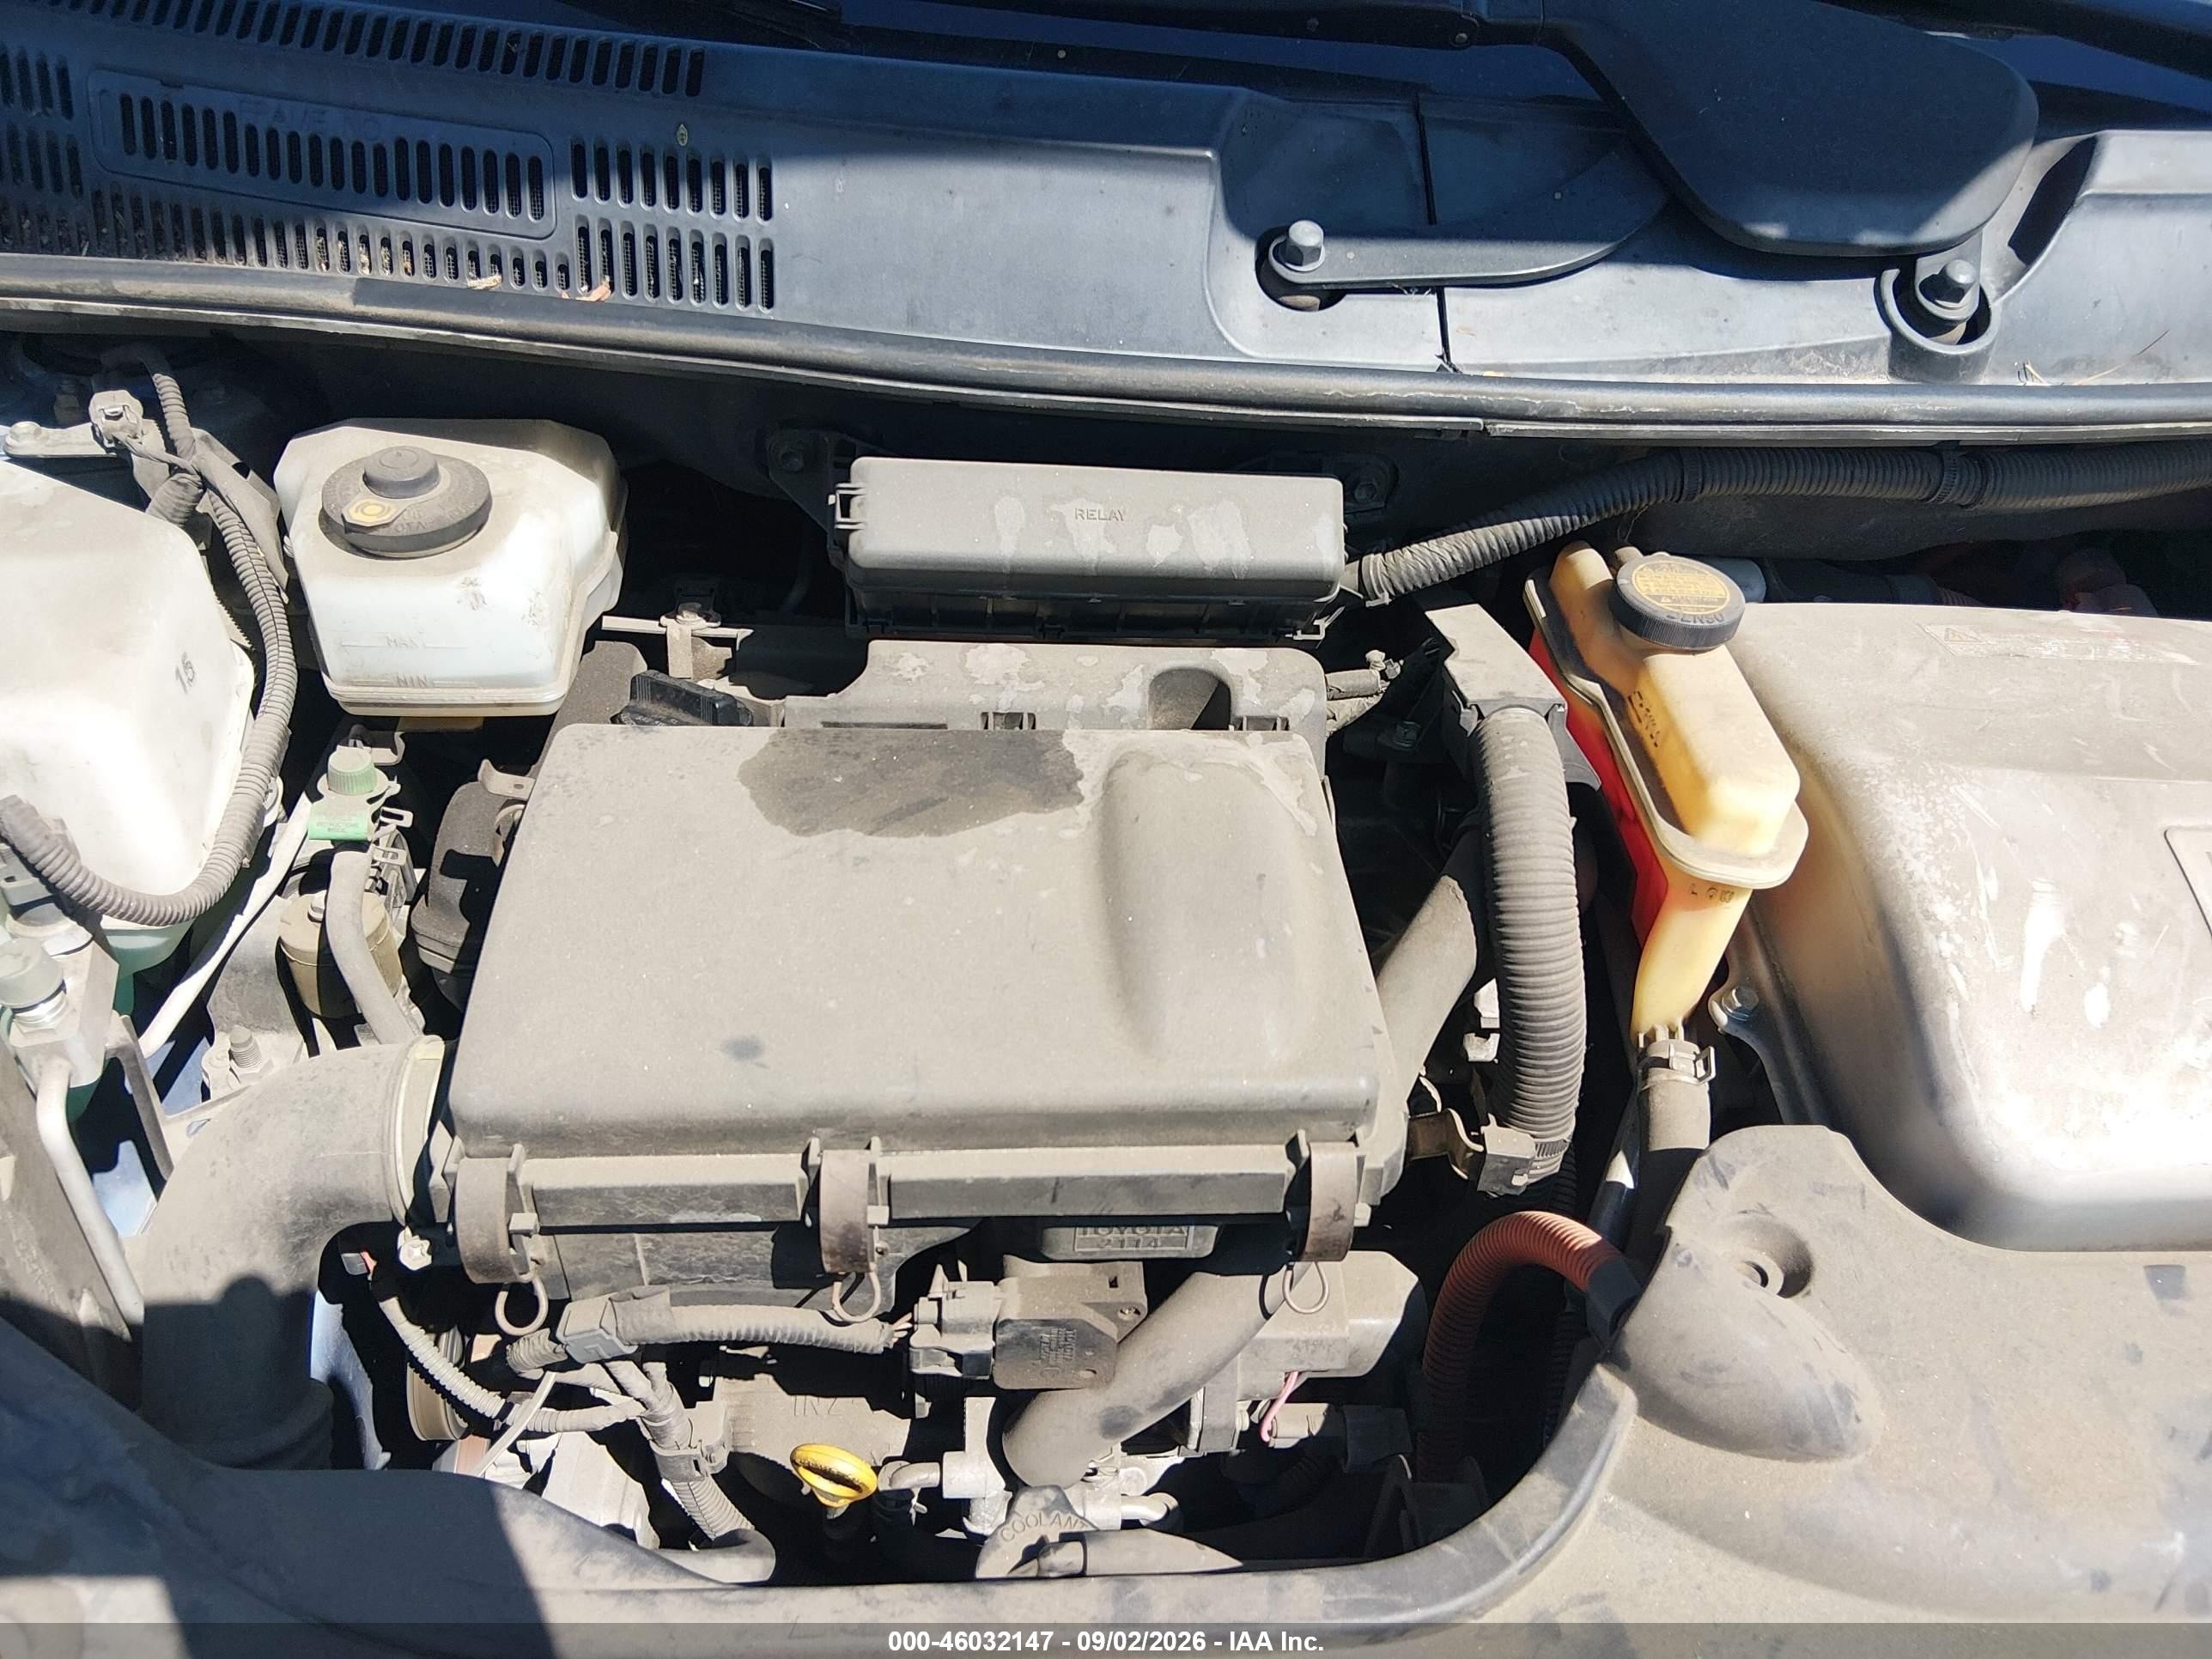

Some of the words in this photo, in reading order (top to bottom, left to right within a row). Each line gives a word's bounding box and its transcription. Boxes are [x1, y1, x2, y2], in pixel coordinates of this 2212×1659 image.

[1074, 507, 1127, 521] RELAY
[1666, 612, 1725, 624] DENSO
[396, 673, 428, 688] MIN
[1000, 1511, 1087, 1542] COOLANT
